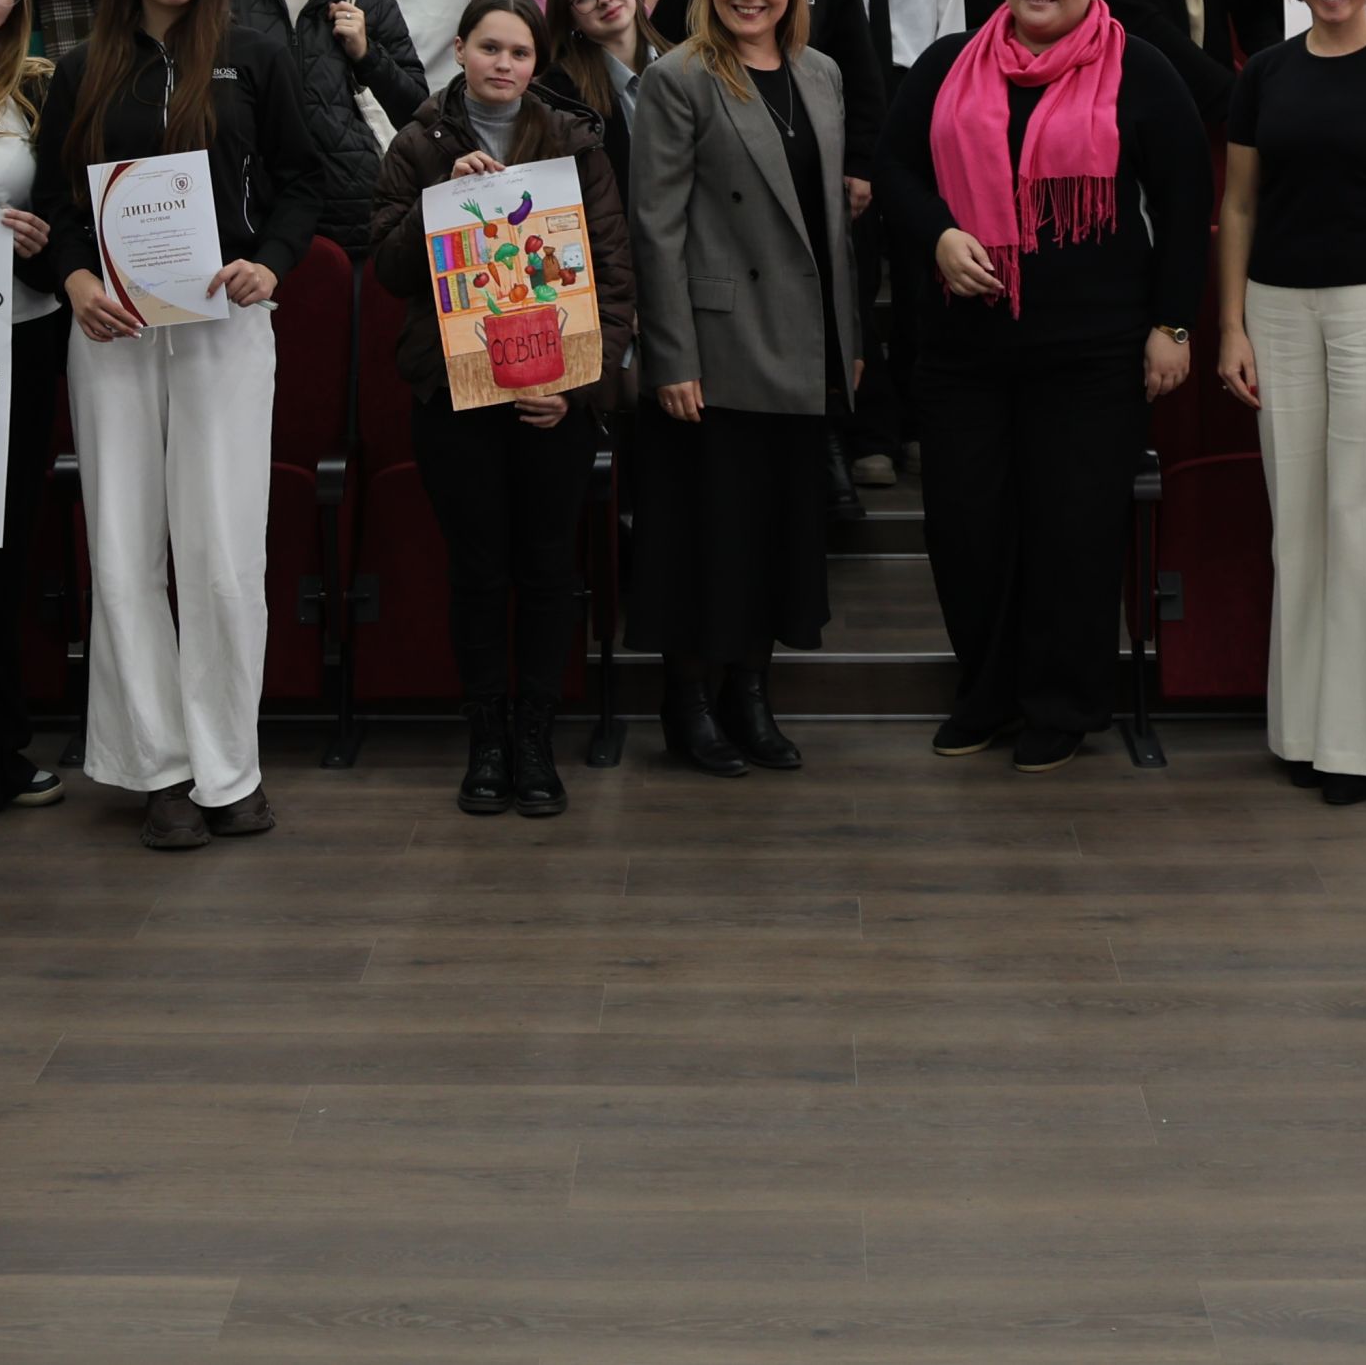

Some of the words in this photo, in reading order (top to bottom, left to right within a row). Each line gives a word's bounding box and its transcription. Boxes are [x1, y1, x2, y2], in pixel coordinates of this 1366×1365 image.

[213, 67, 238, 75] BOSS
[121, 199, 186, 218] ДИПЛОМ
[490, 330, 558, 366] ОСВІТА
